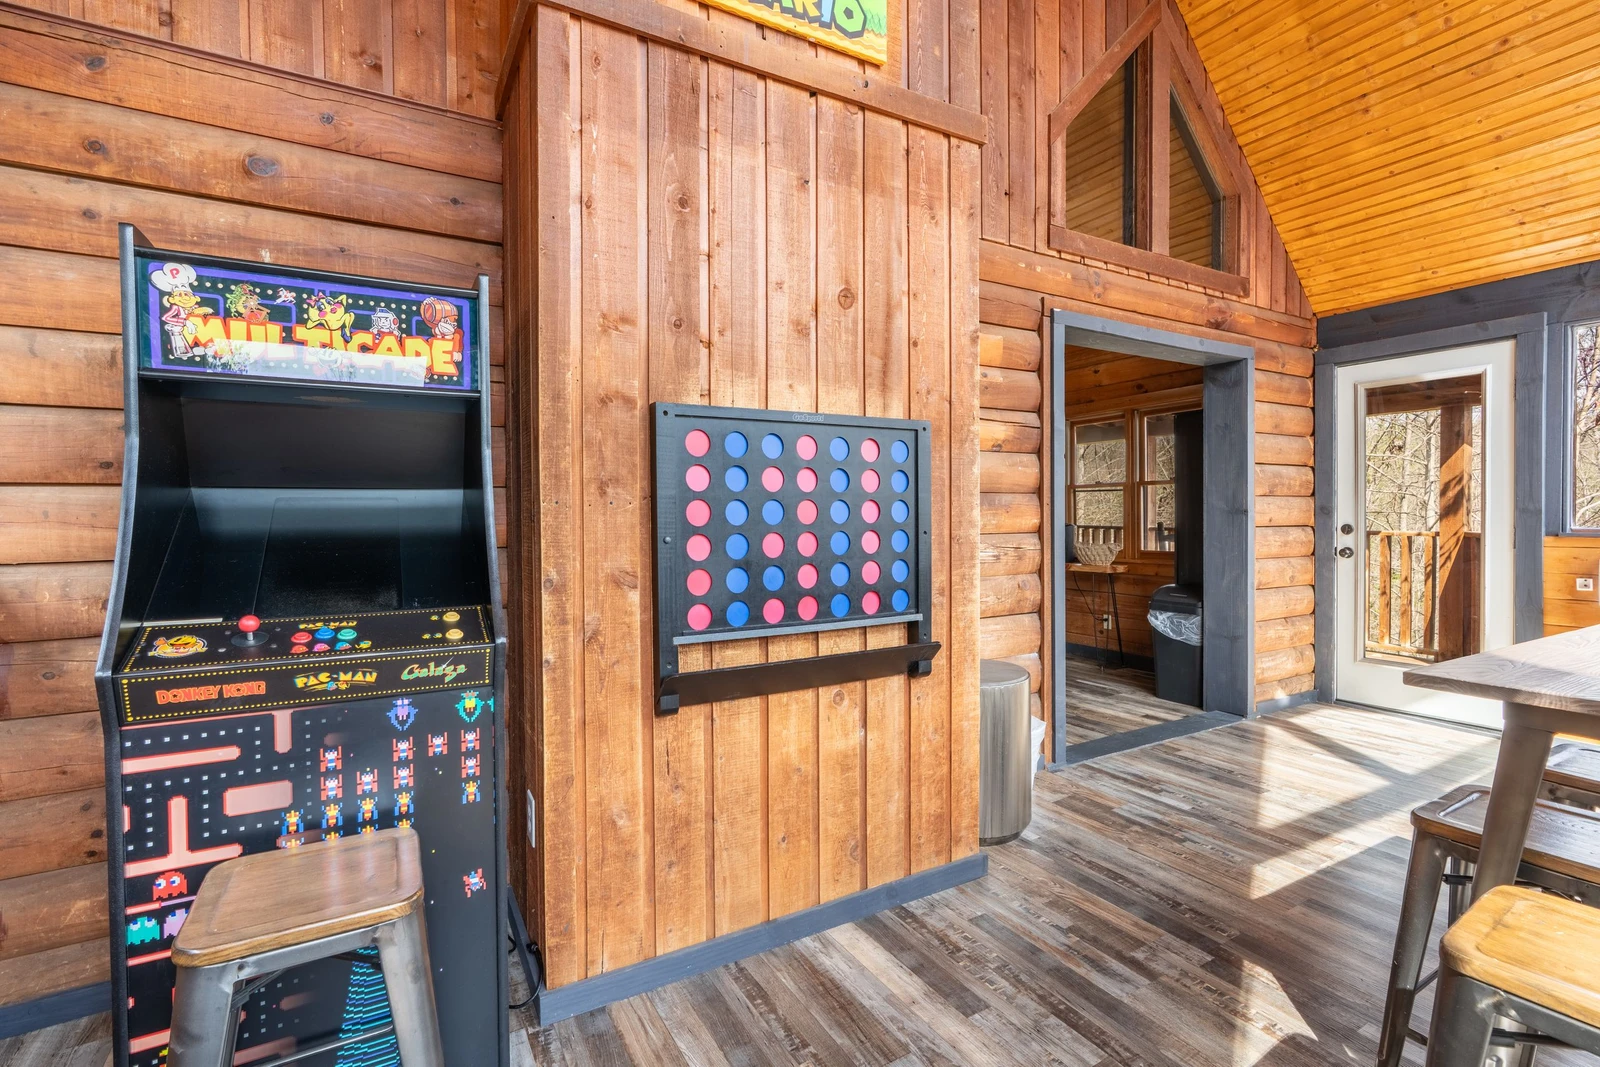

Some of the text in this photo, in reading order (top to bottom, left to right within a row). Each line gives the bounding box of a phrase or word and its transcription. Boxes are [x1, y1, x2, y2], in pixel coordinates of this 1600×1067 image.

[169, 267, 180, 279] P
[294, 670, 378, 689] PAC-MAN
[401, 661, 468, 683] Galaga
[155, 680, 266, 705] DONKEY KONG
